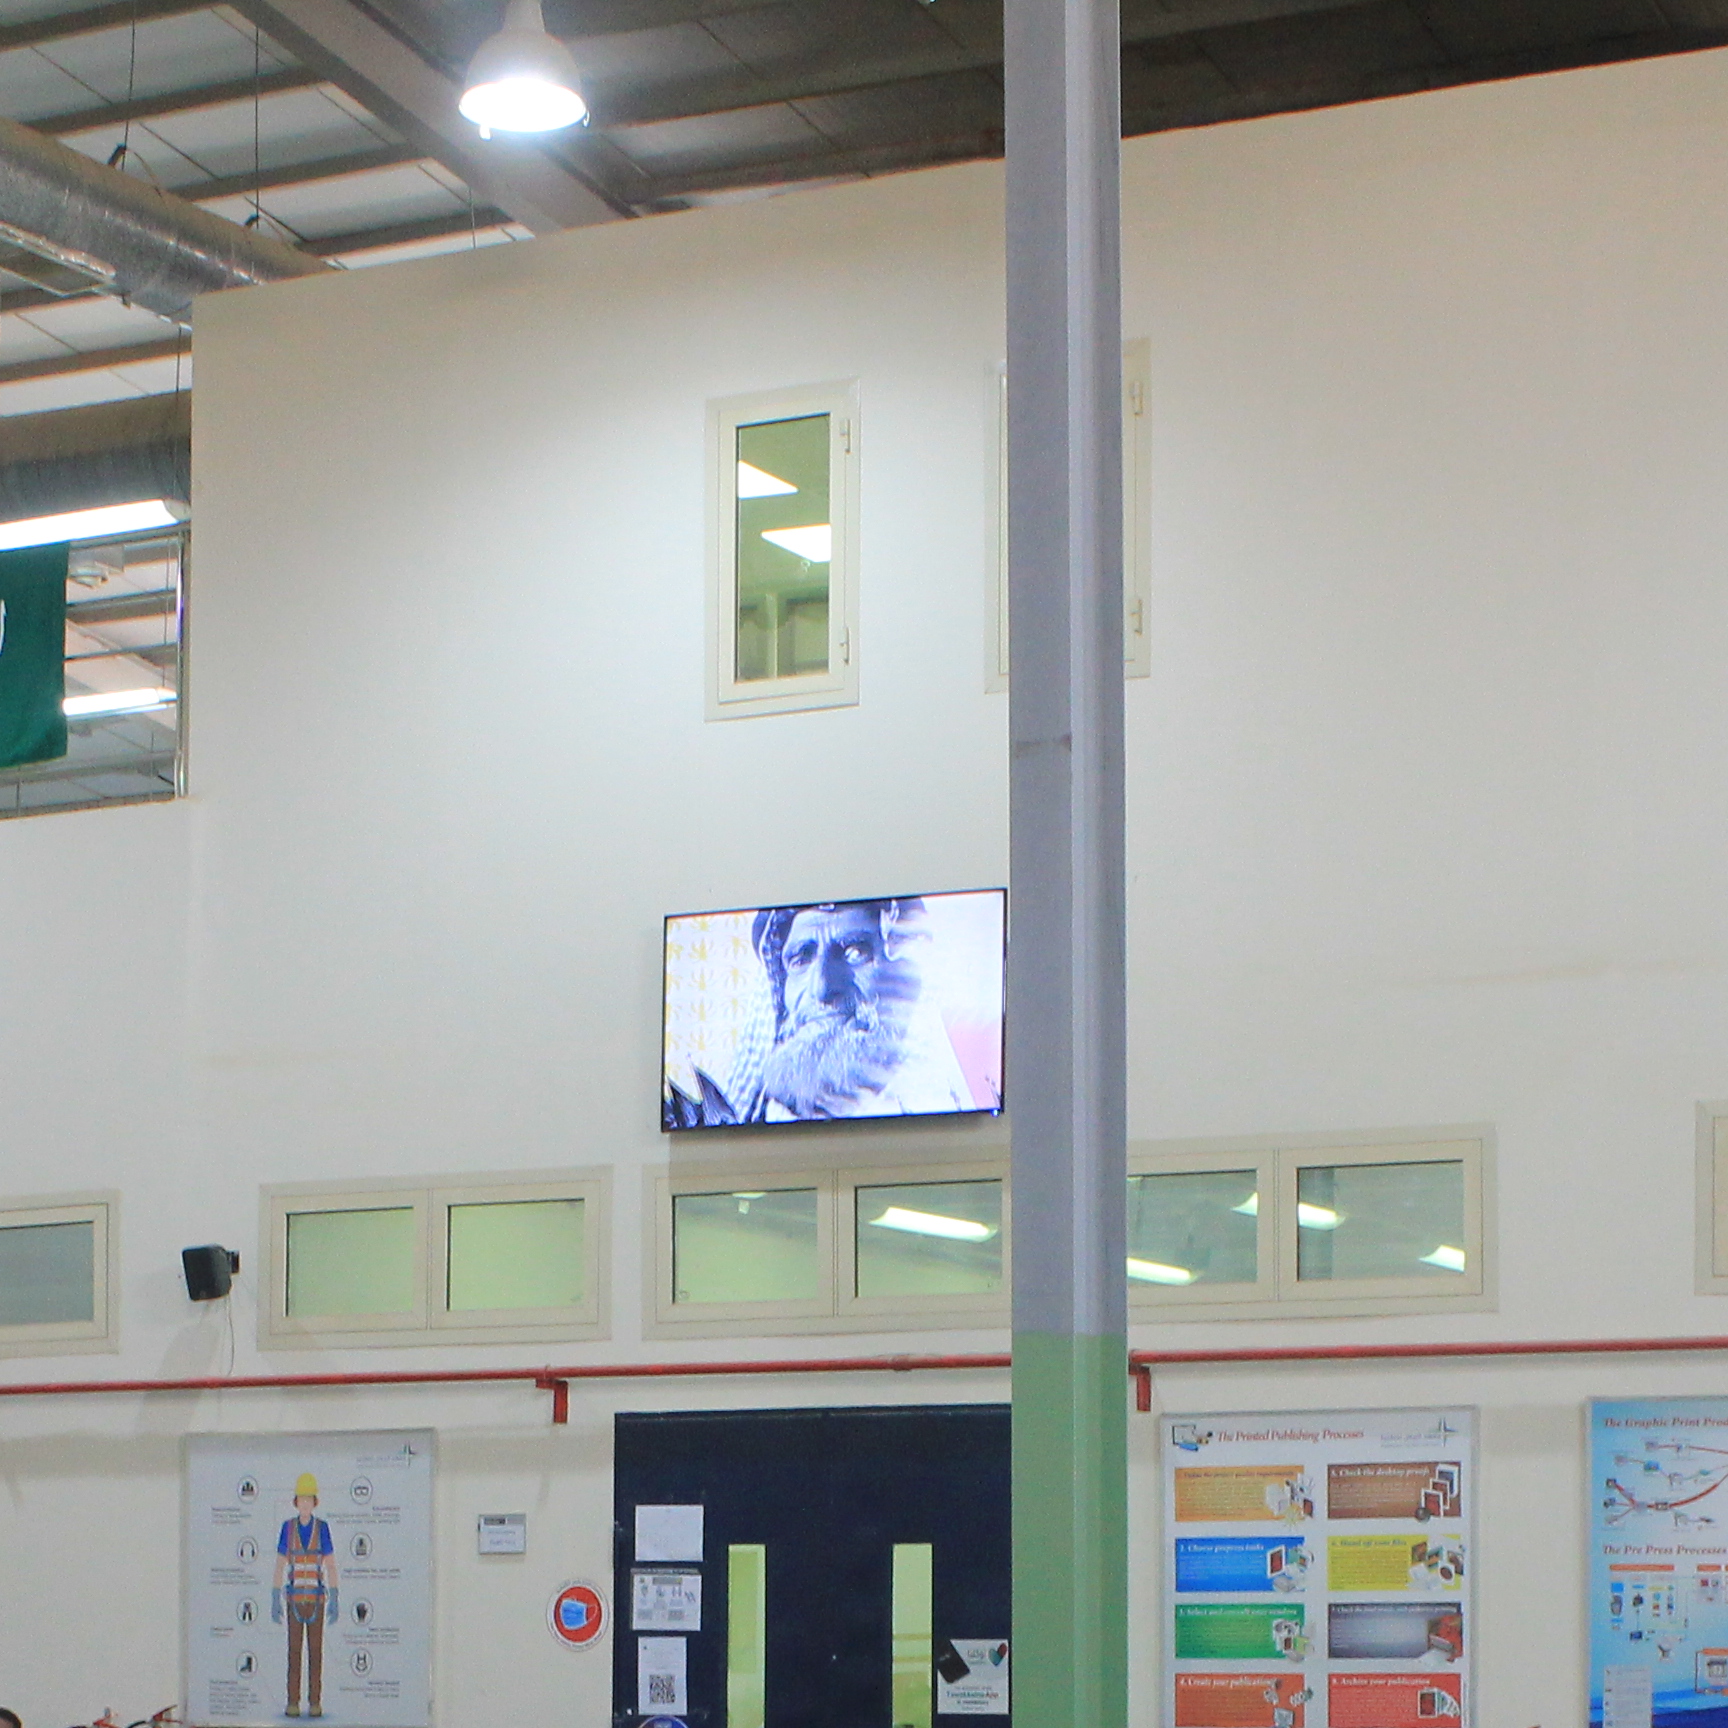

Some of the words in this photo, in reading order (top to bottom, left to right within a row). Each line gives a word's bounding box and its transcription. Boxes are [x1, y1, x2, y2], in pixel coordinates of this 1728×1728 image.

[1625, 1417, 1668, 1430] Graphic
[1672, 1416, 1700, 1427] Print
[1236, 1429, 1269, 1442] Printed
[1271, 1428, 1320, 1444] Publishing
[1323, 1428, 1365, 1440] Processes
[1645, 1544, 1673, 1555] Press
[1676, 1544, 1727, 1555] Processes
